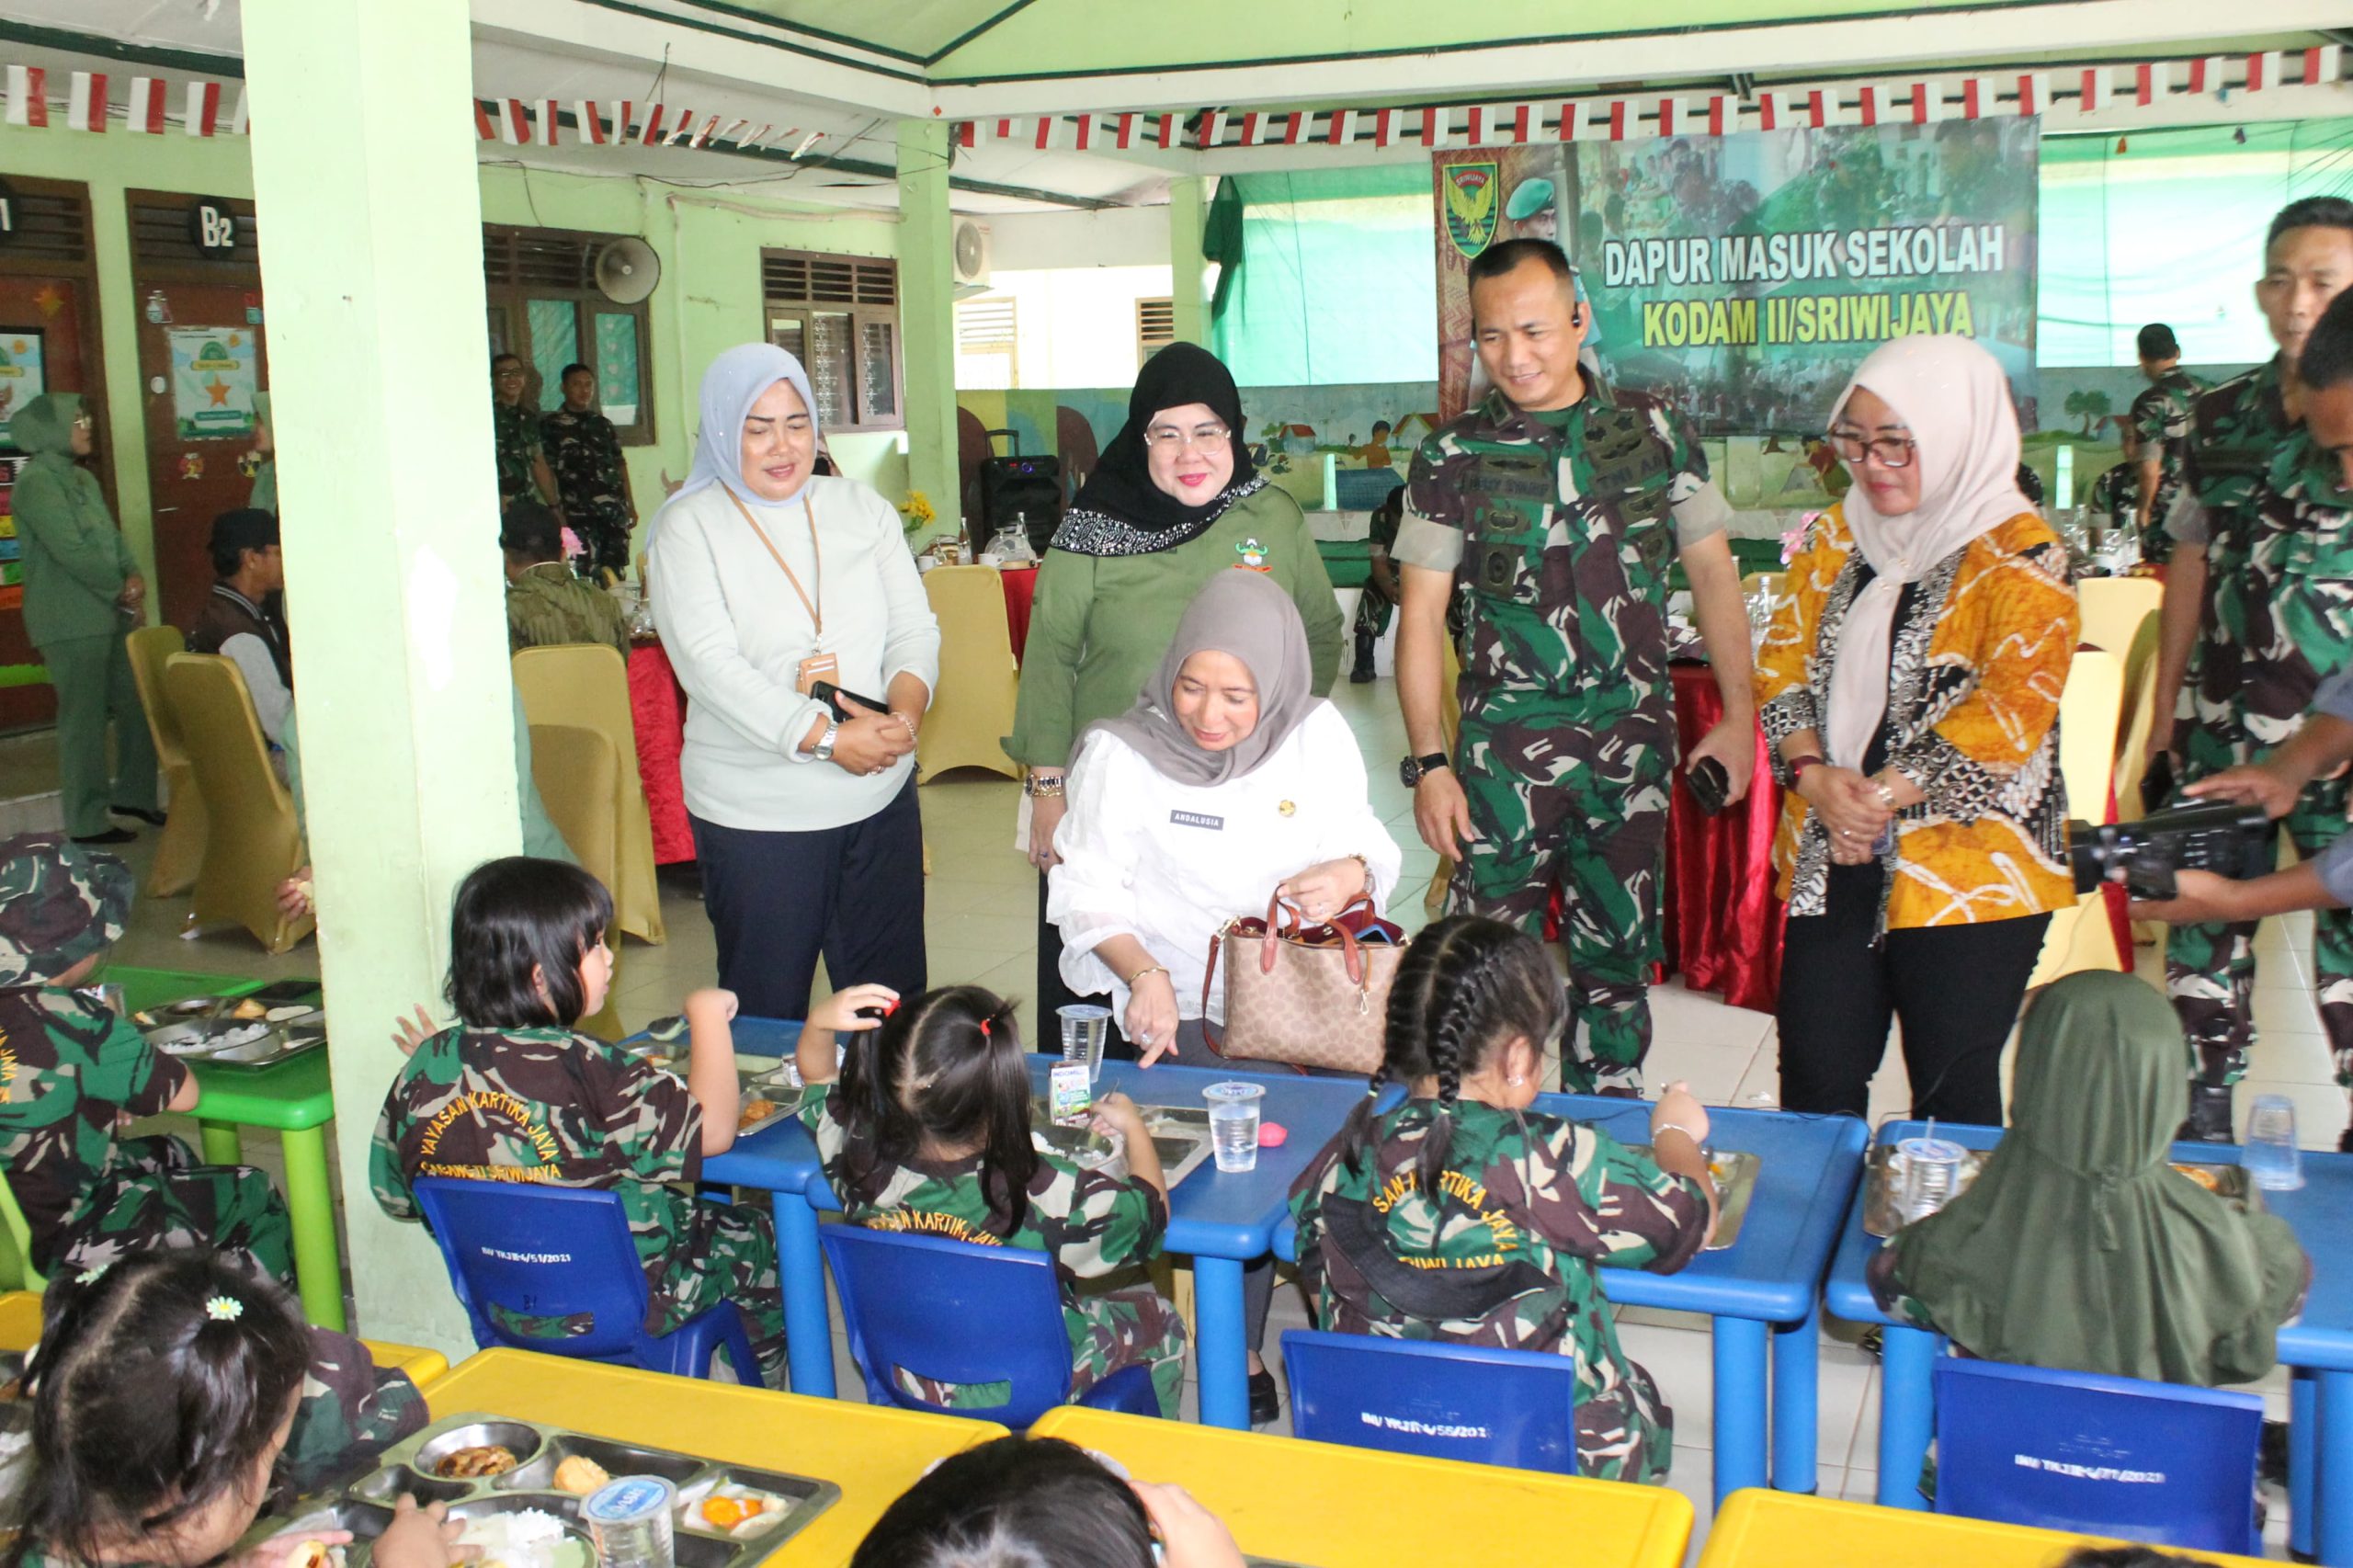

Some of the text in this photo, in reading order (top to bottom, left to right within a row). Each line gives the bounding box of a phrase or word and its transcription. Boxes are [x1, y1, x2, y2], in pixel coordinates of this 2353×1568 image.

[200, 206, 233, 247] B2
[1604, 224, 2005, 287] DAPUR MASUK SEKOLAH
[1643, 290, 1974, 347] KODAM II/SRIWIJAYA
[1175, 812, 1220, 826] ANDALUSIA
[420, 1090, 560, 1162] YAYASAN KARTIKA JAYA
[1481, 1209, 1519, 1252] JAYA
